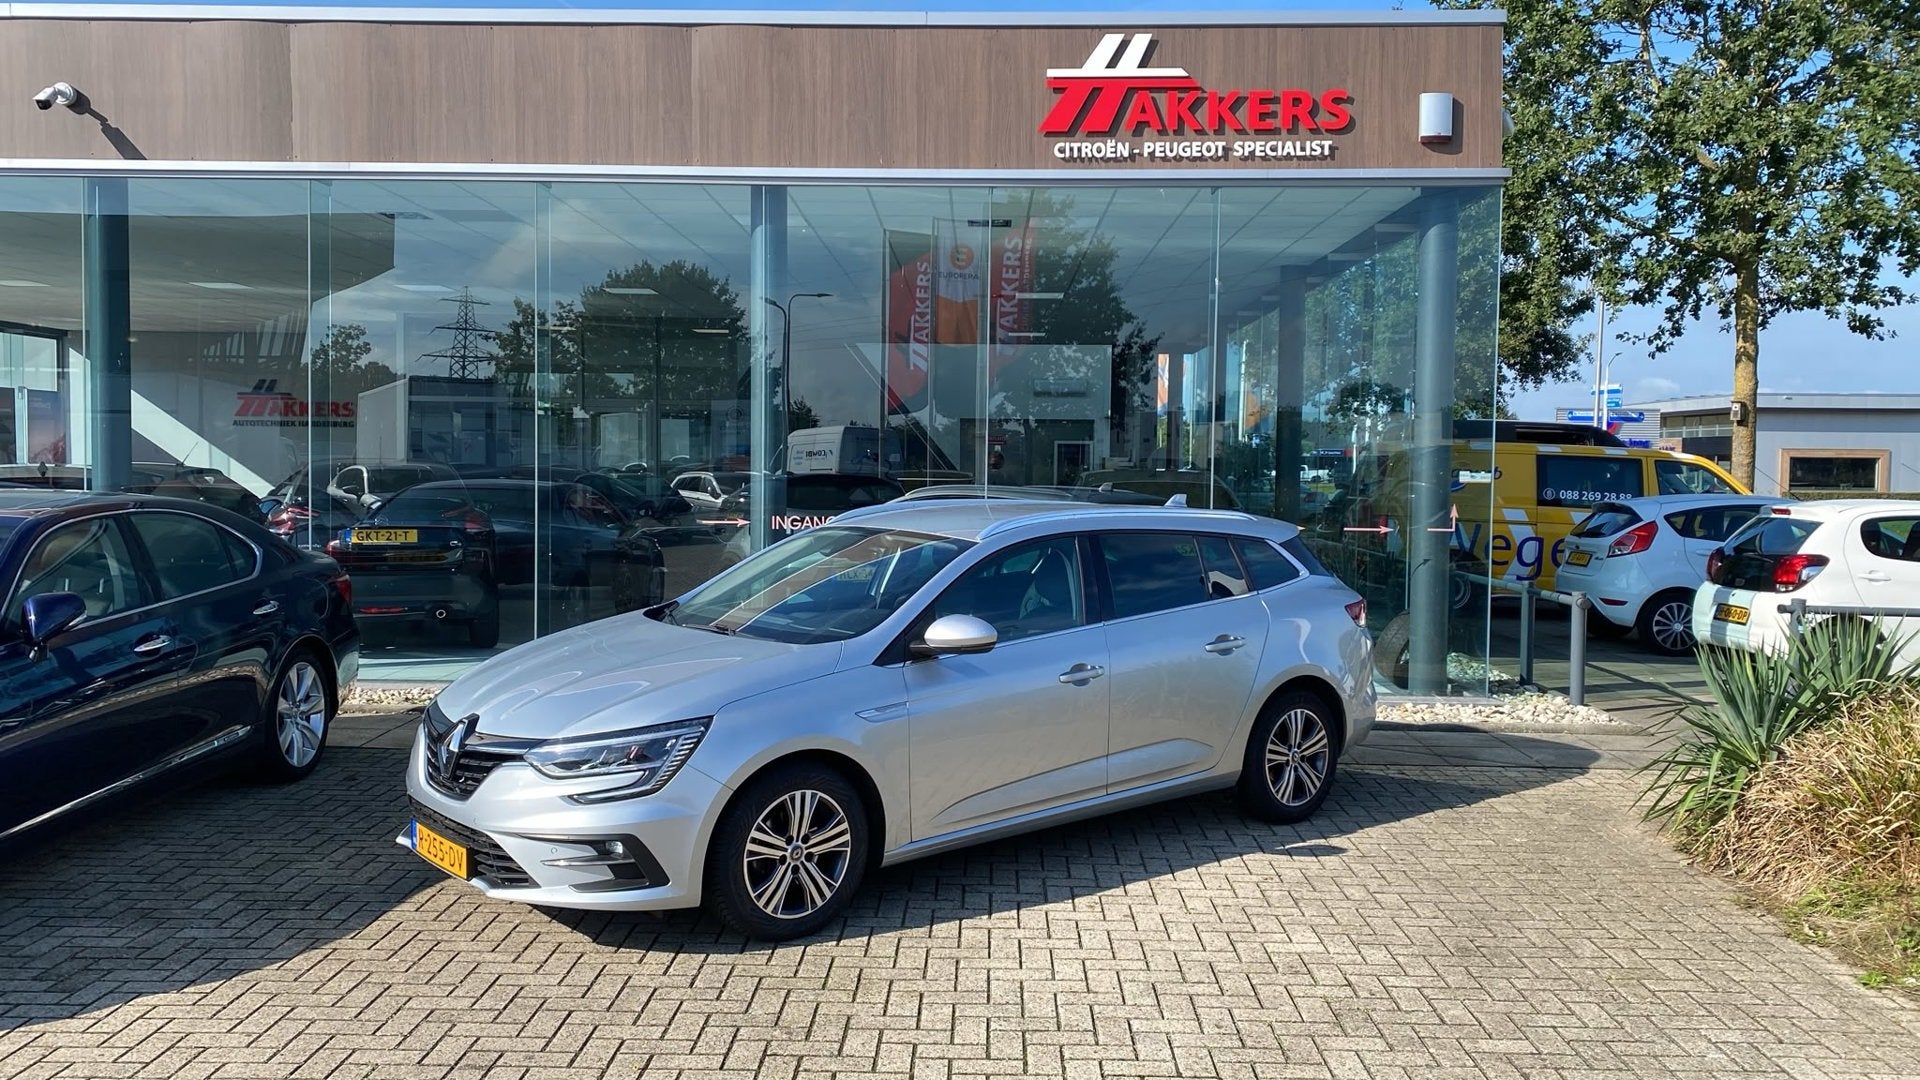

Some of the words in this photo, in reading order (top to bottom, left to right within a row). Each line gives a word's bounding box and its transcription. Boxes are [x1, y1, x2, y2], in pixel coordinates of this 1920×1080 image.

[1038, 33, 1351, 132] HAKKERS
[1053, 139, 1129, 158] CITROËN
[1143, 141, 1226, 157] PEUGEOT
[1233, 140, 1333, 157] SPECIALIST
[1559, 490, 1580, 500] 088
[1582, 491, 1601, 501] 269
[1604, 492, 1617, 502] 28
[356, 530, 410, 541] GKT-21-T
[418, 828, 464, 872] R-255-DV
